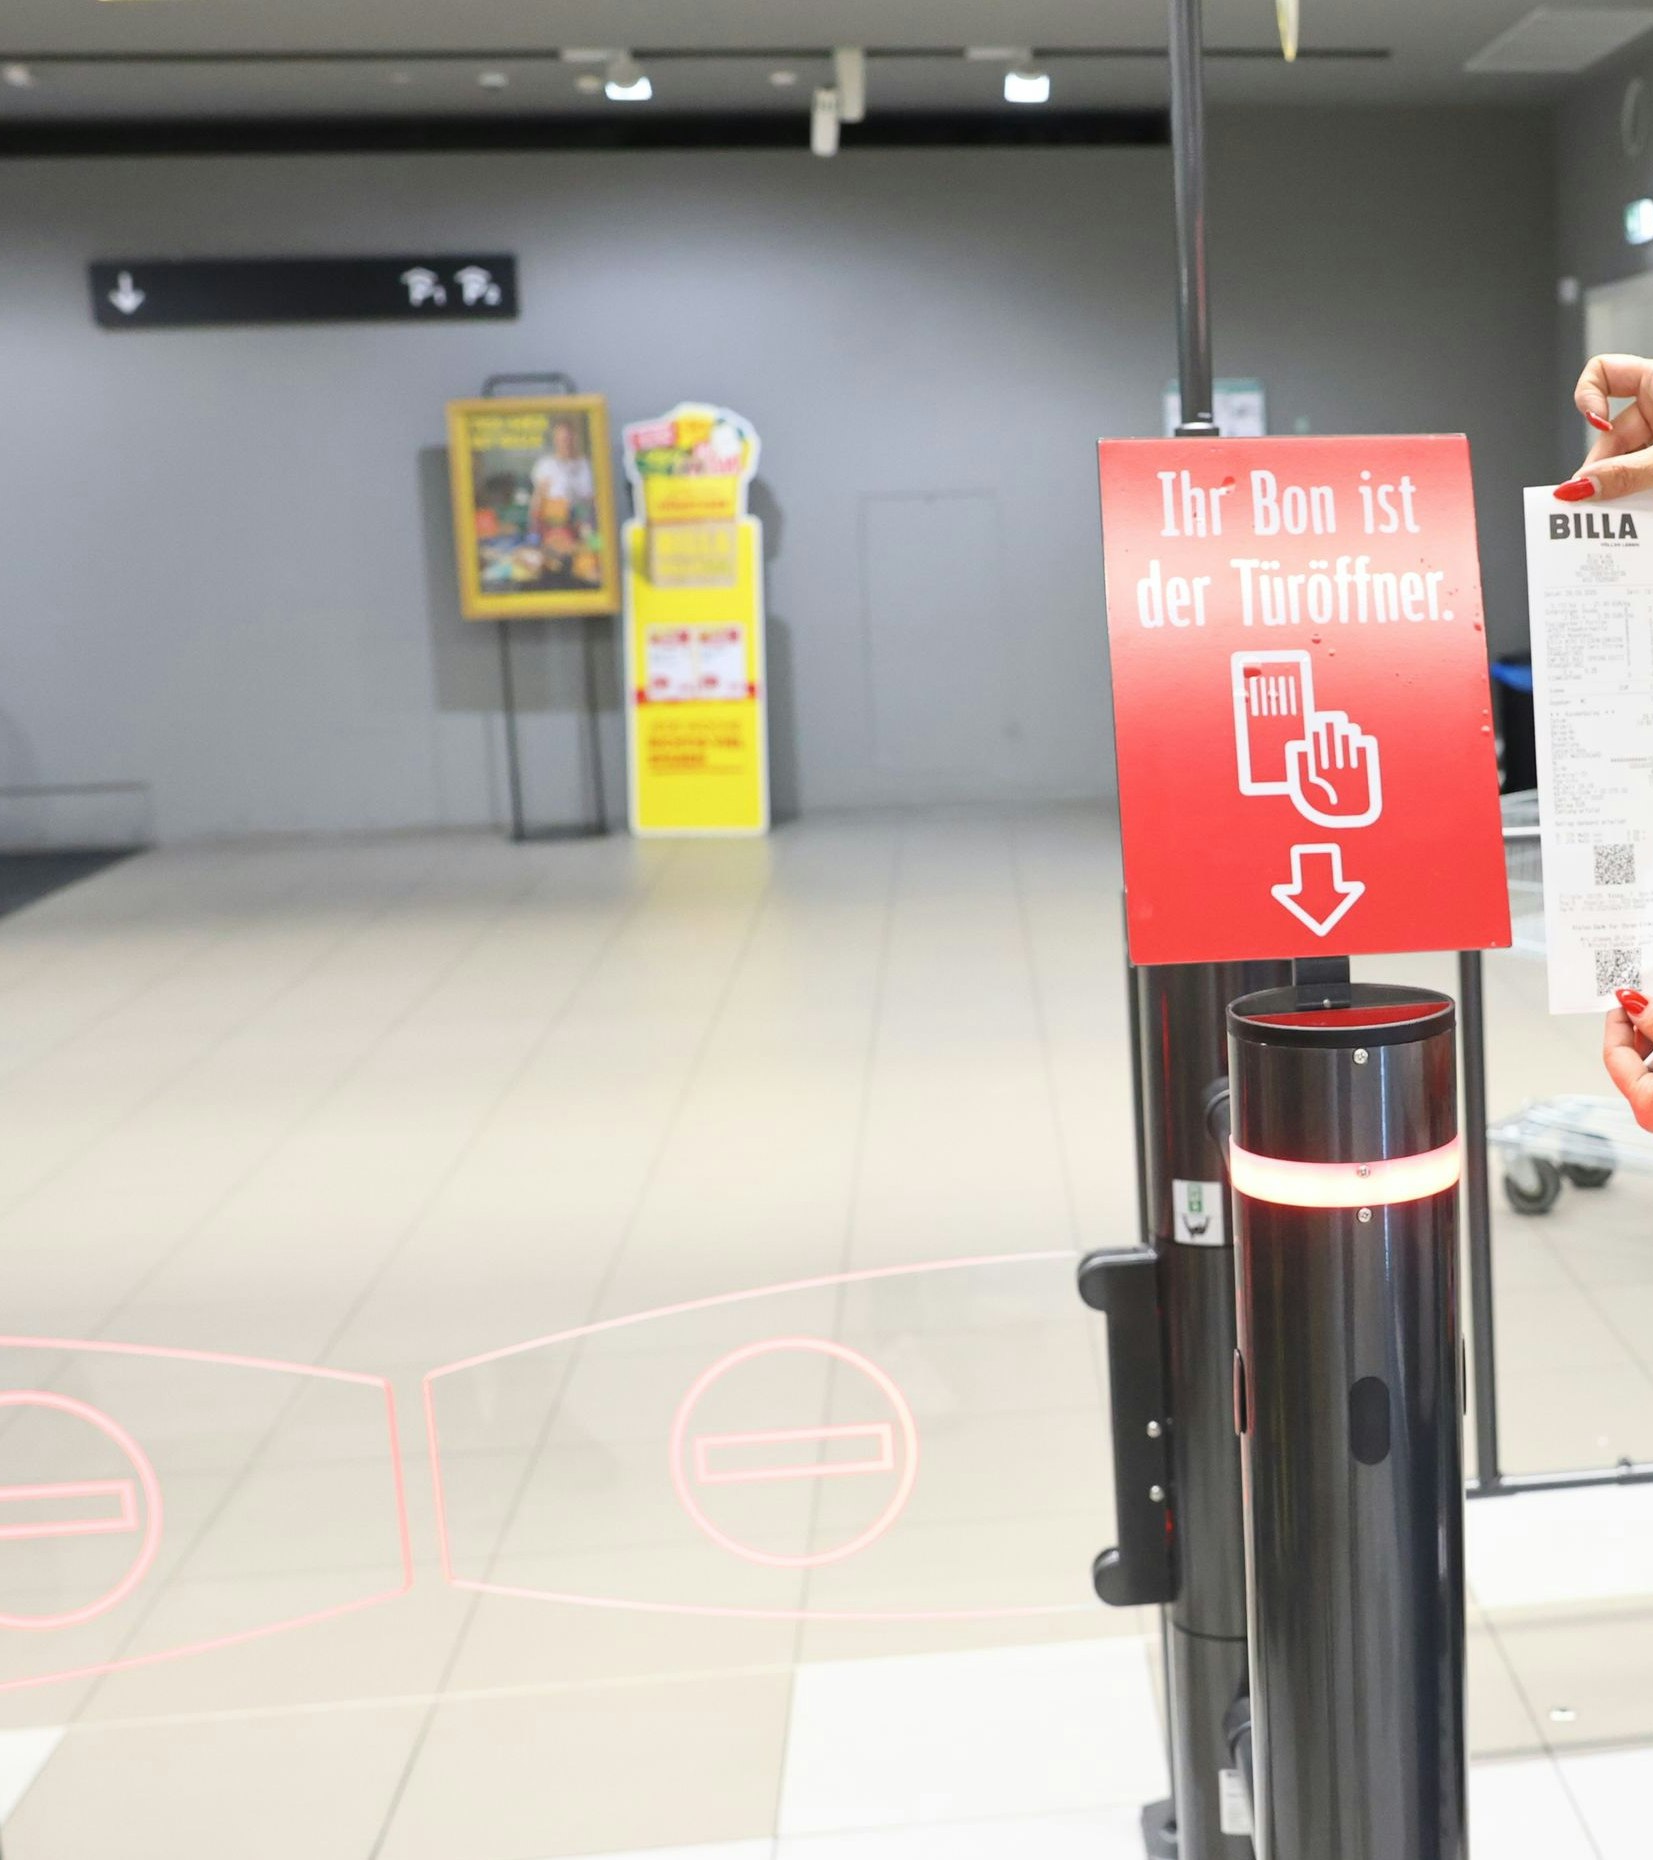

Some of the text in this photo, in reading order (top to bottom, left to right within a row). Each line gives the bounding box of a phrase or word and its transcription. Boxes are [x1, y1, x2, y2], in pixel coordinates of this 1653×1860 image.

[1157, 470, 1420, 538] Ihr Bon ist
[1549, 513, 1638, 539] BILLA
[1137, 555, 1454, 628] der Türöffner.
